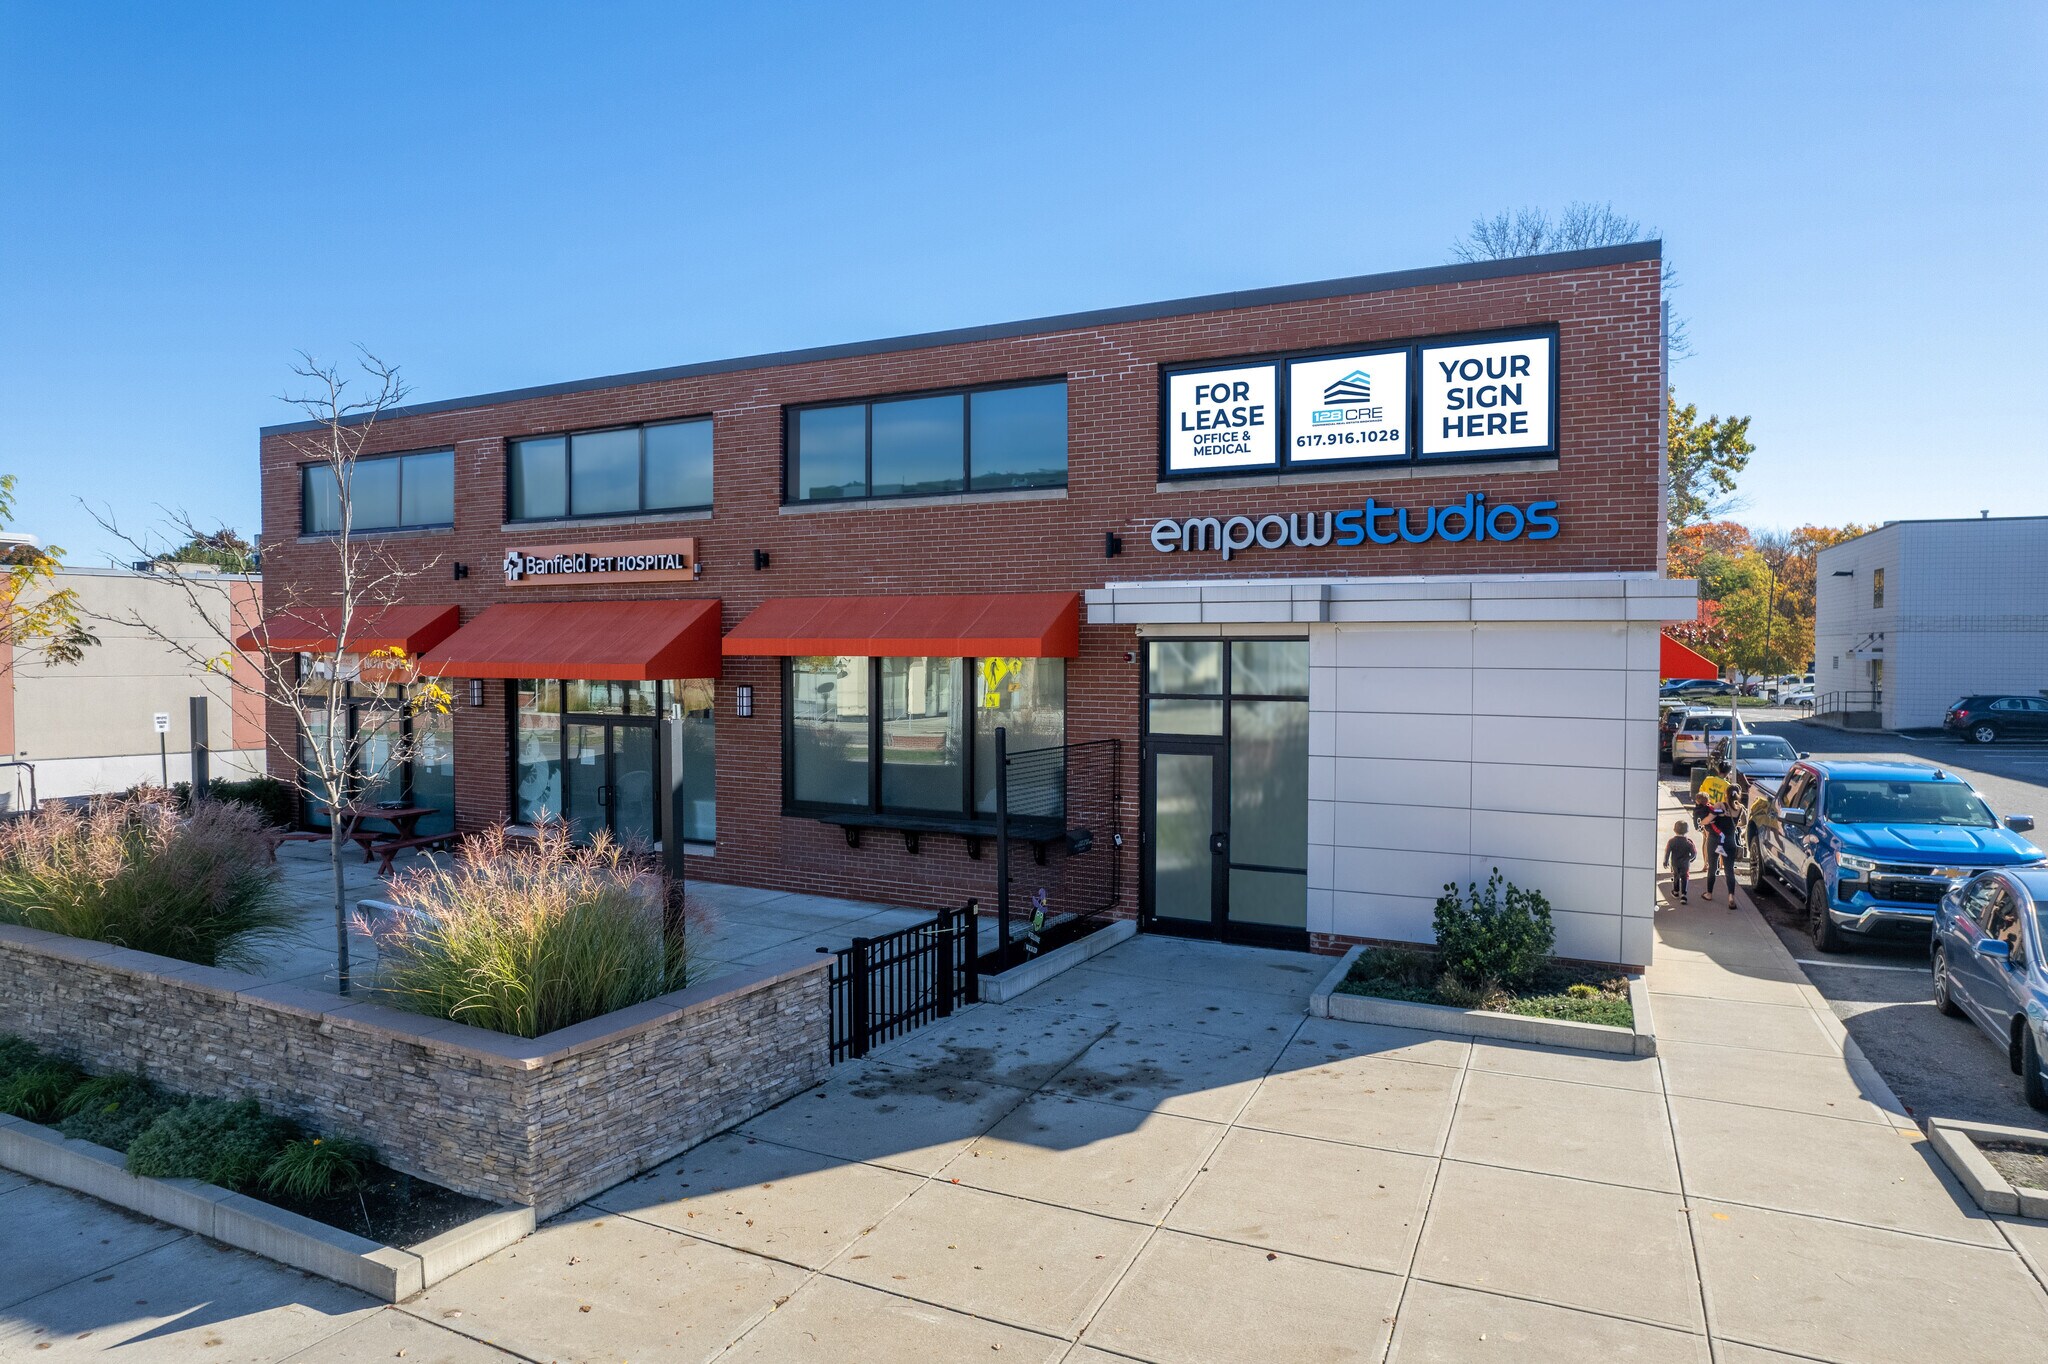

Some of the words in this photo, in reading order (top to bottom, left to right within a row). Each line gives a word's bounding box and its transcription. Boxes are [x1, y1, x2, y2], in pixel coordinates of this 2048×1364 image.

[1438, 354, 1531, 383] YOUR
[1195, 381, 1250, 406] FOR
[1446, 383, 1522, 411] SIGN
[1181, 405, 1265, 432] LEASE
[1313, 410, 1342, 422] 128
[1345, 406, 1383, 421] CRE
[1442, 411, 1529, 439] HERE
[1193, 431, 1239, 445] OFFICE
[1242, 430, 1251, 441] &
[1193, 442, 1251, 456] MEDICAL
[1296, 429, 1400, 448] 617.916.1028
[525, 552, 588, 575] Banfield
[589, 556, 614, 572] PET
[616, 553, 685, 571] HOSPITAL
